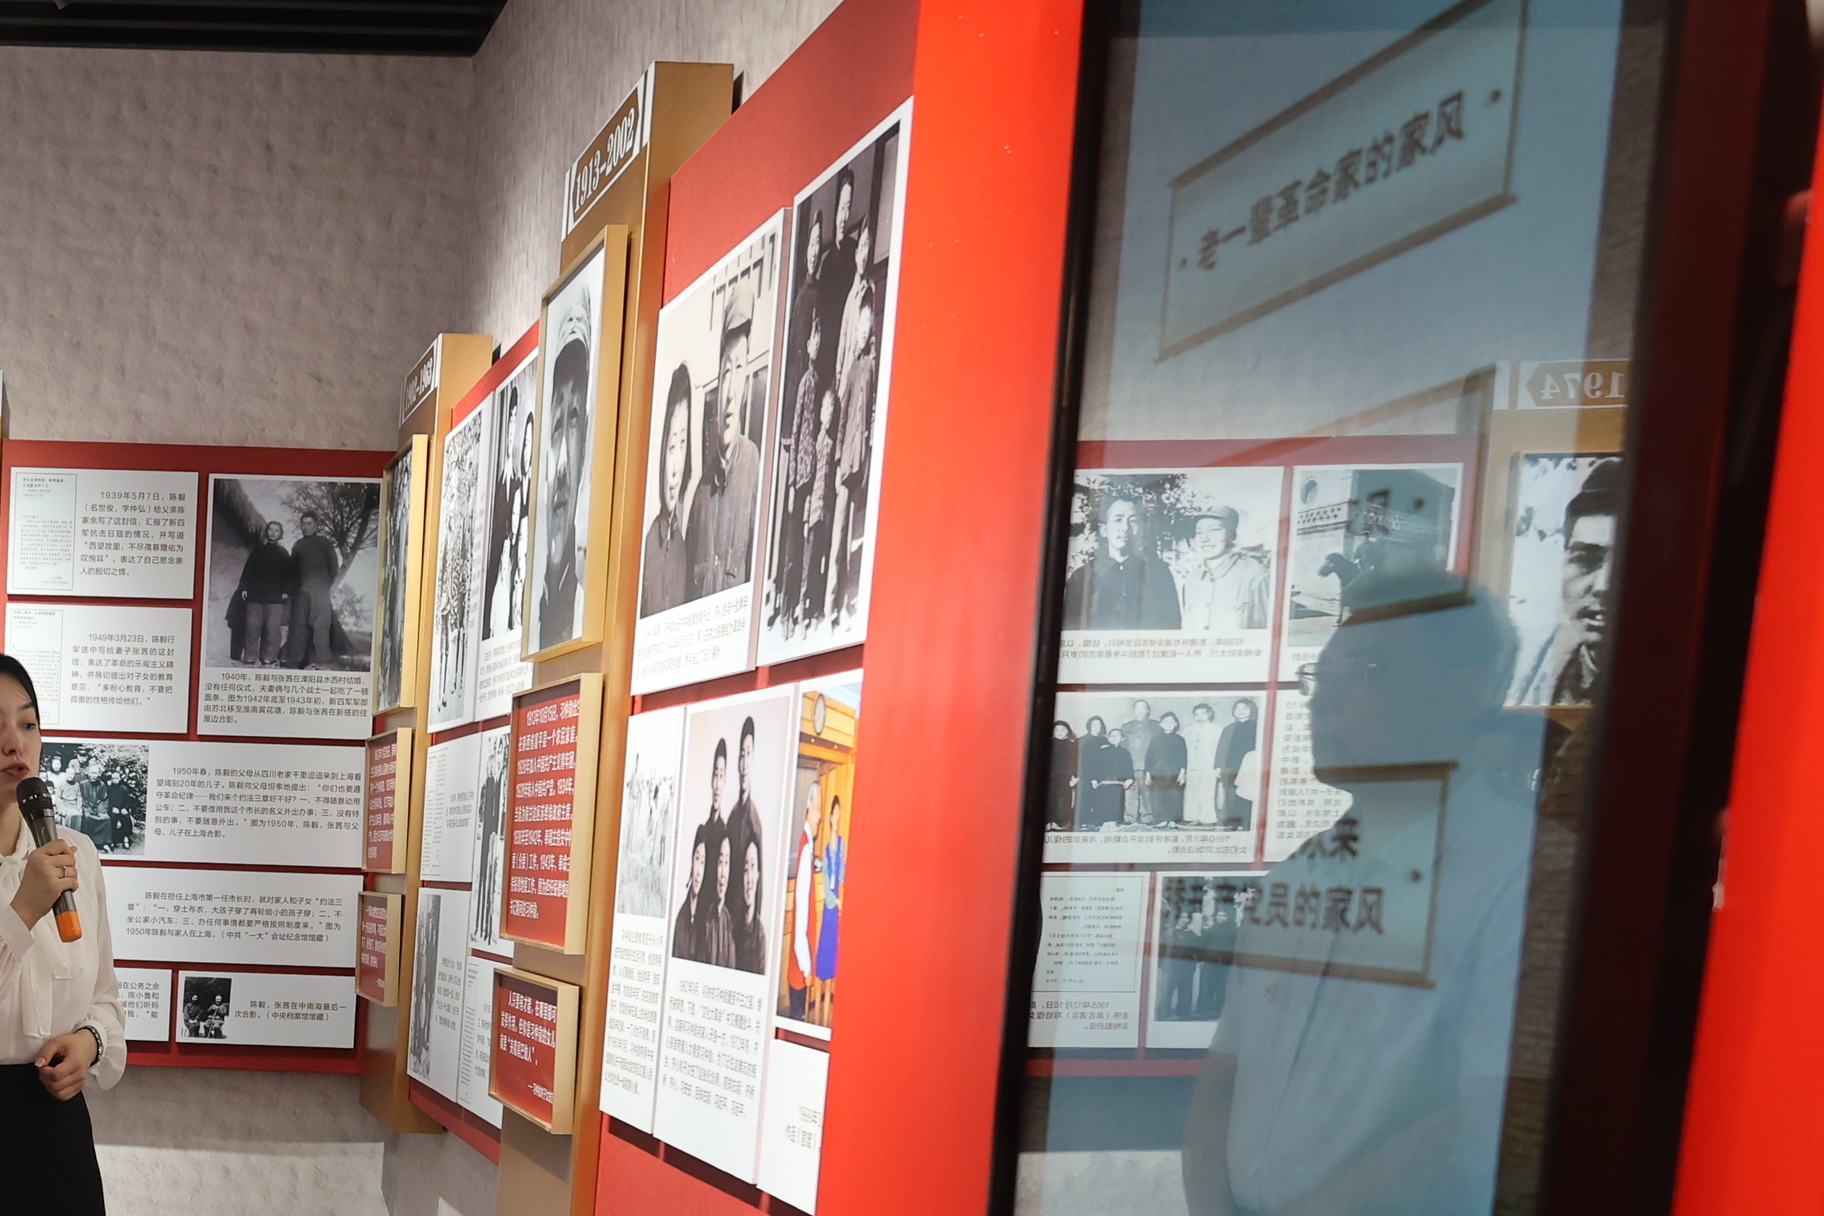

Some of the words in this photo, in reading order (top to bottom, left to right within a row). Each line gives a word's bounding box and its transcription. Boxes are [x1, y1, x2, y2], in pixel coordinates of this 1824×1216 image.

[100, 491, 186, 502] 1939年5月7日，陈毅
[84, 504, 185, 514] （名世俊，字仲弘）给父亲陈
[81, 516, 185, 527] 家余写了这封信，汇报了新四
[81, 529, 185, 540] 军抗击日寇的情况，并写道
[80, 567, 130, 576] 人的殷切之情。
[88, 633, 175, 644] 1949年3月23日，陈毅行
[72, 645, 175, 656] 军途中写给妻子张茜的这封
[71, 658, 174, 669] 信，表达了革命的乐观主义精
[71, 670, 173, 681] 神，并恳切提出对子女的教育
[204, 683, 369, 696] 没有任何仪式，夫妻俩与几个战士一起吃了一顿
[204, 694, 368, 706] 面条。图为1942年底至1943年初，新四军军部
[203, 704, 368, 717] 由苏北移至淮南黄花塘，陈毅与张茜在新搭的住
[203, 715, 238, 724] 屋边合影。
[172, 767, 361, 781] 1950年春，陈毅的父母从四川老家千里迢迢来到上海看
[155, 804, 360, 818] 公车；二、不要借用我这个市长的名义外出办事；三、没有特
[154, 828, 226, 839] 母、儿子在上海合影。
[144, 891, 343, 906] 陈毅在担任上海市第一任市长时，就对家人和子女“约法三
[118, 991, 160, 1000] 、陈小鲁和
[250, 1000, 347, 1011] 陈毅、张茜在中南海最后一
[124, 1010, 159, 1019] 我，“能
[234, 1010, 330, 1021] 次合影。（中央档案馆馆藏）
